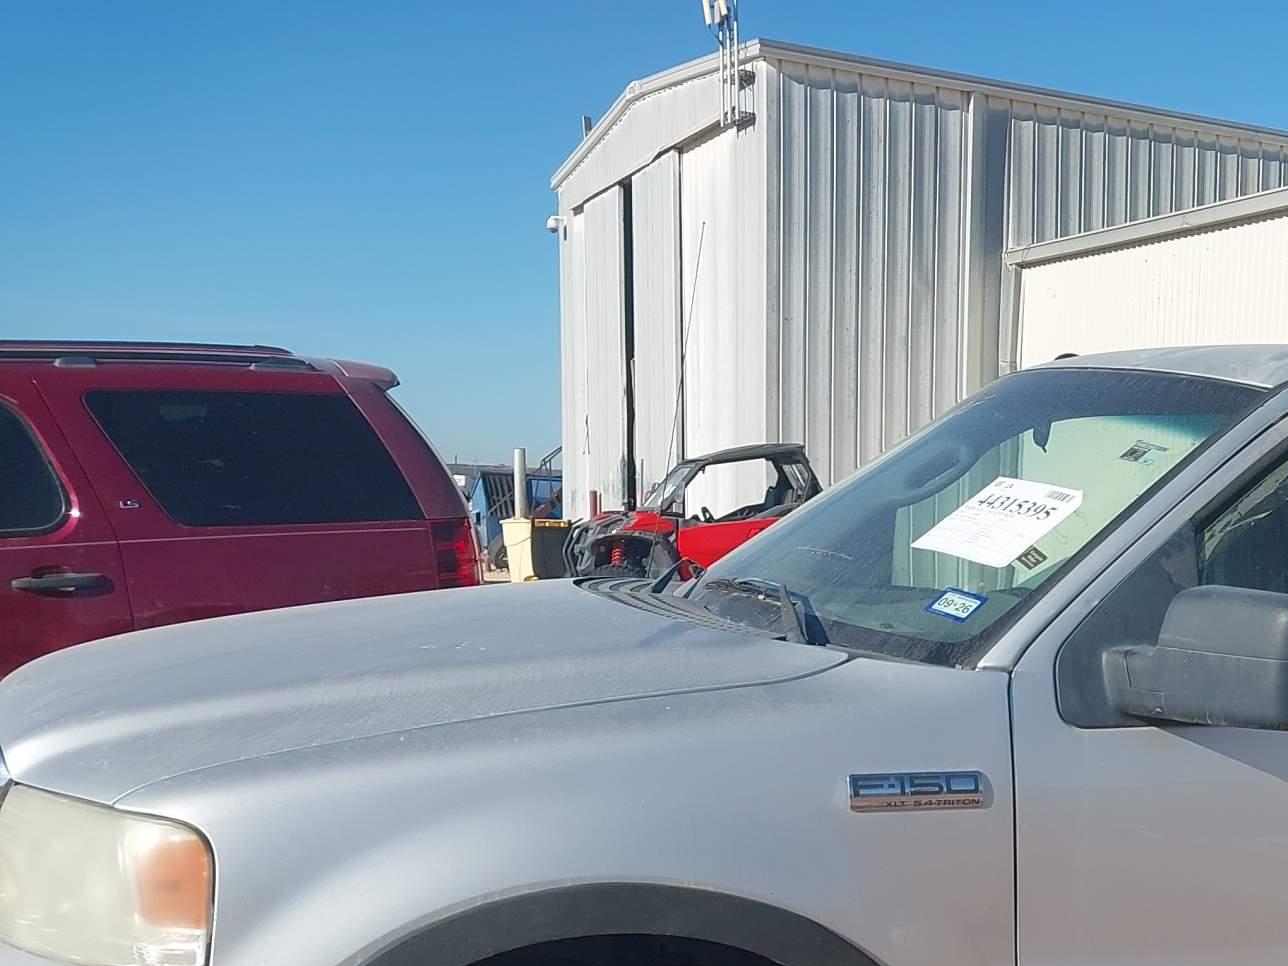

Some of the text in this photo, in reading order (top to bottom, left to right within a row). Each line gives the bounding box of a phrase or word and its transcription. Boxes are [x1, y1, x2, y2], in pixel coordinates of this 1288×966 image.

[977, 491, 1059, 522] 44315395
[937, 597, 973, 614] 09 26
[852, 774, 981, 798] F-150
[885, 800, 906, 808] XLT
